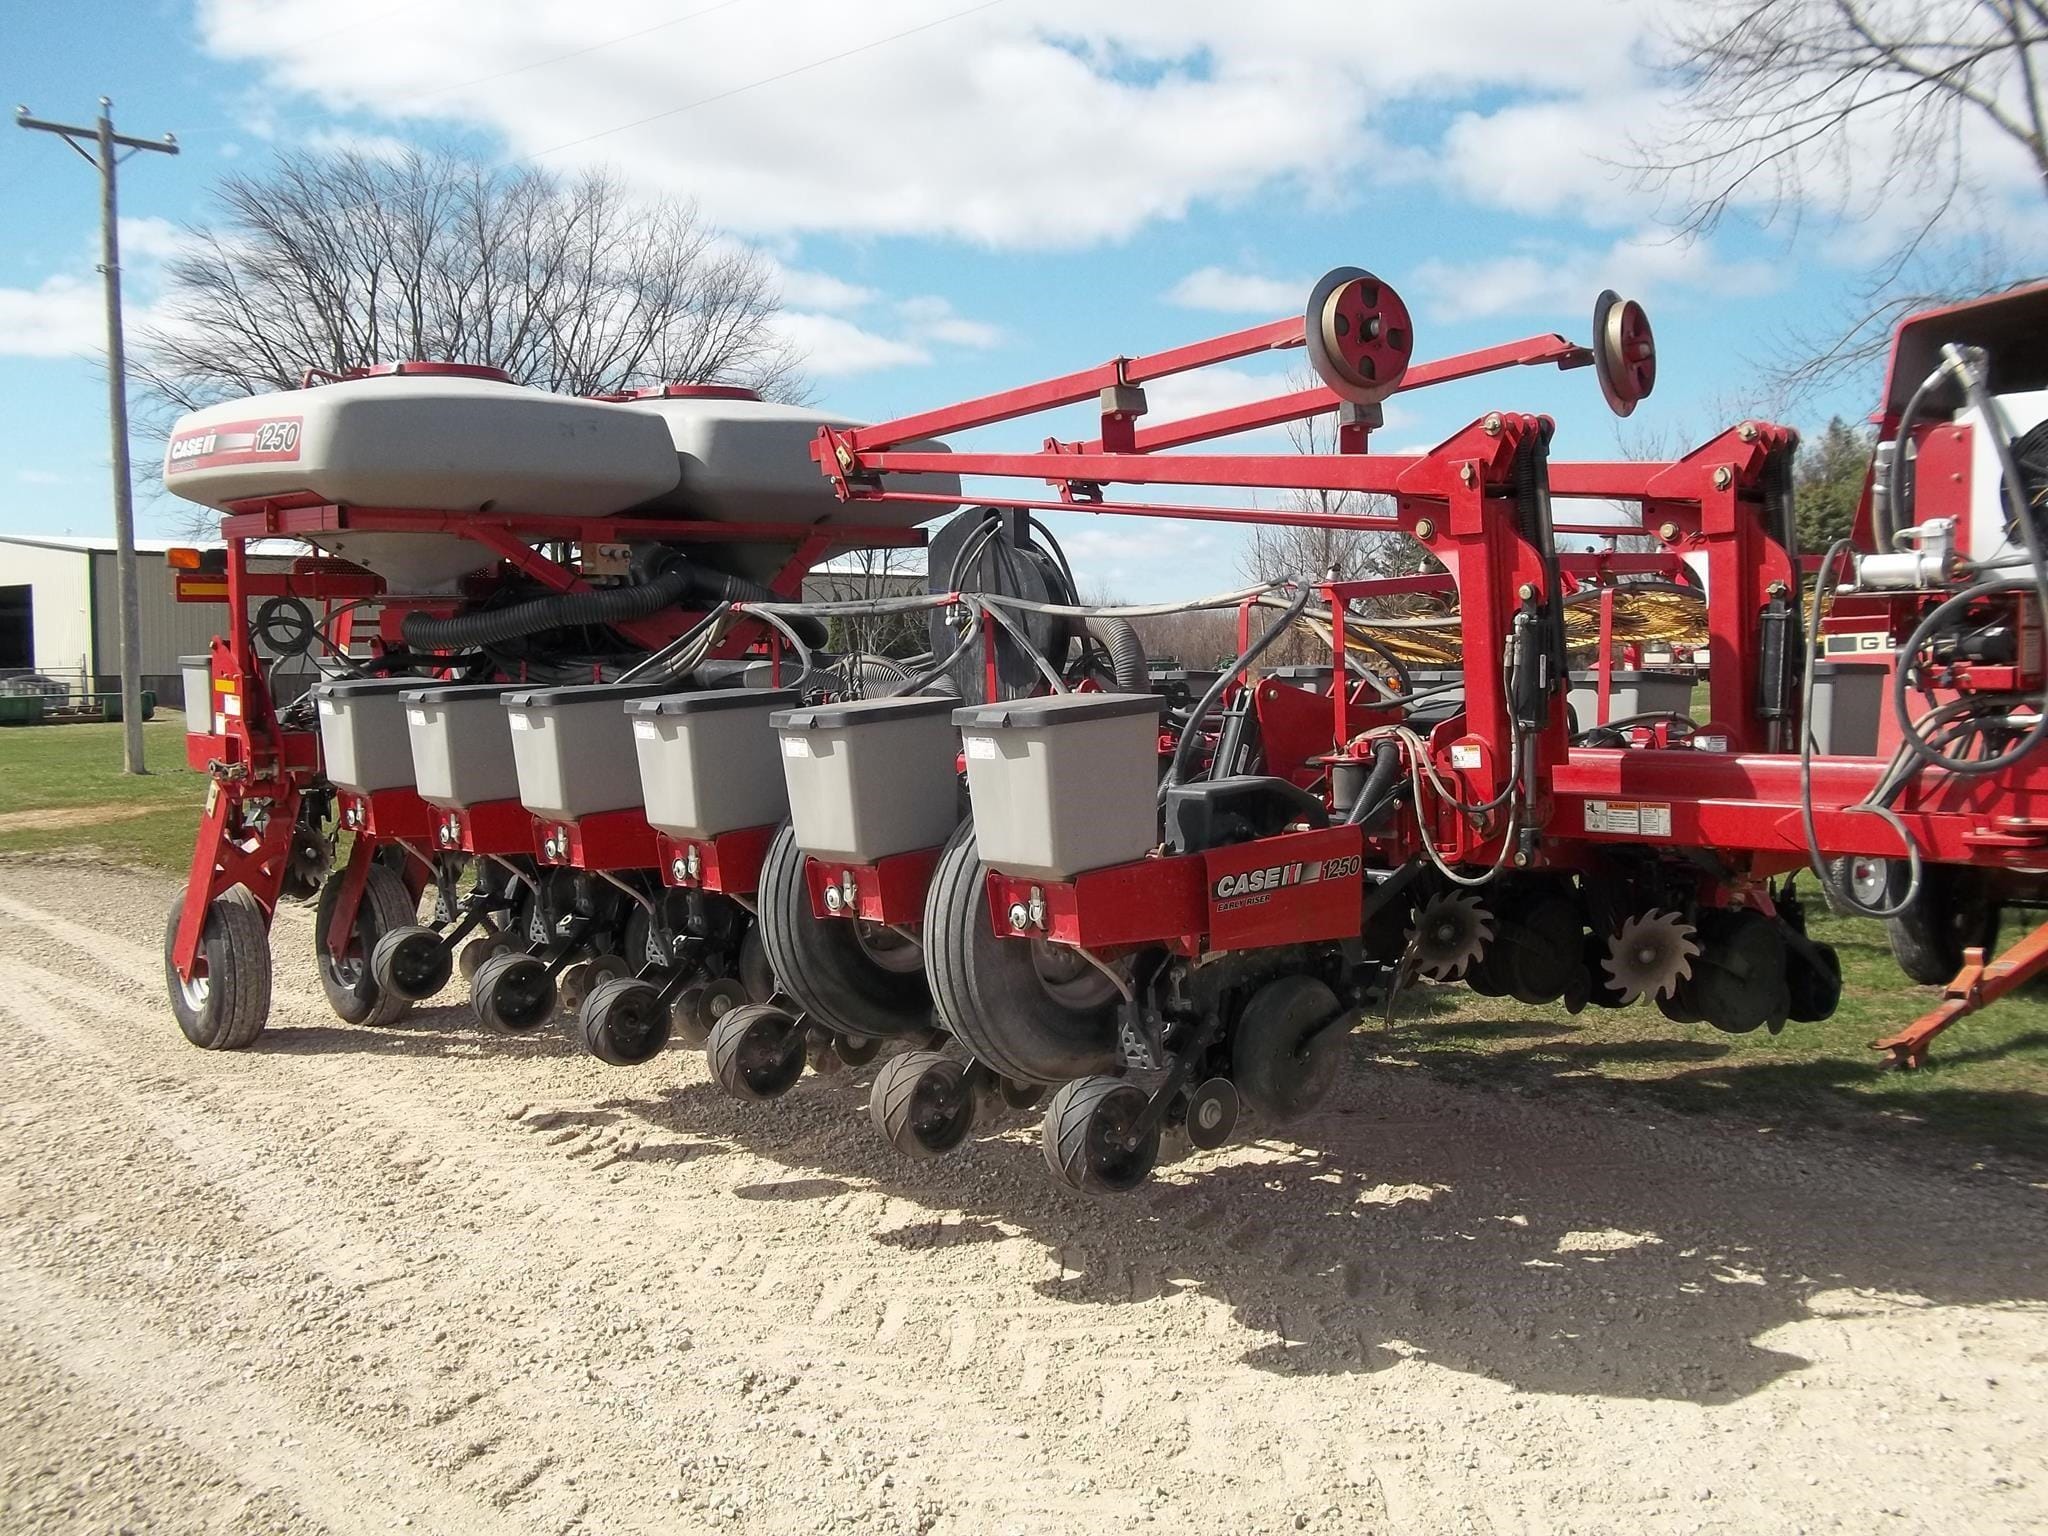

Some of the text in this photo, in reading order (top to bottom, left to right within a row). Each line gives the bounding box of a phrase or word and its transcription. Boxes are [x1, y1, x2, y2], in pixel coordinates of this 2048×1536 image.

[255, 422, 300, 452] 1250
[1322, 855, 1361, 881] 1250
[1217, 894, 1271, 913] EARLY RISER
